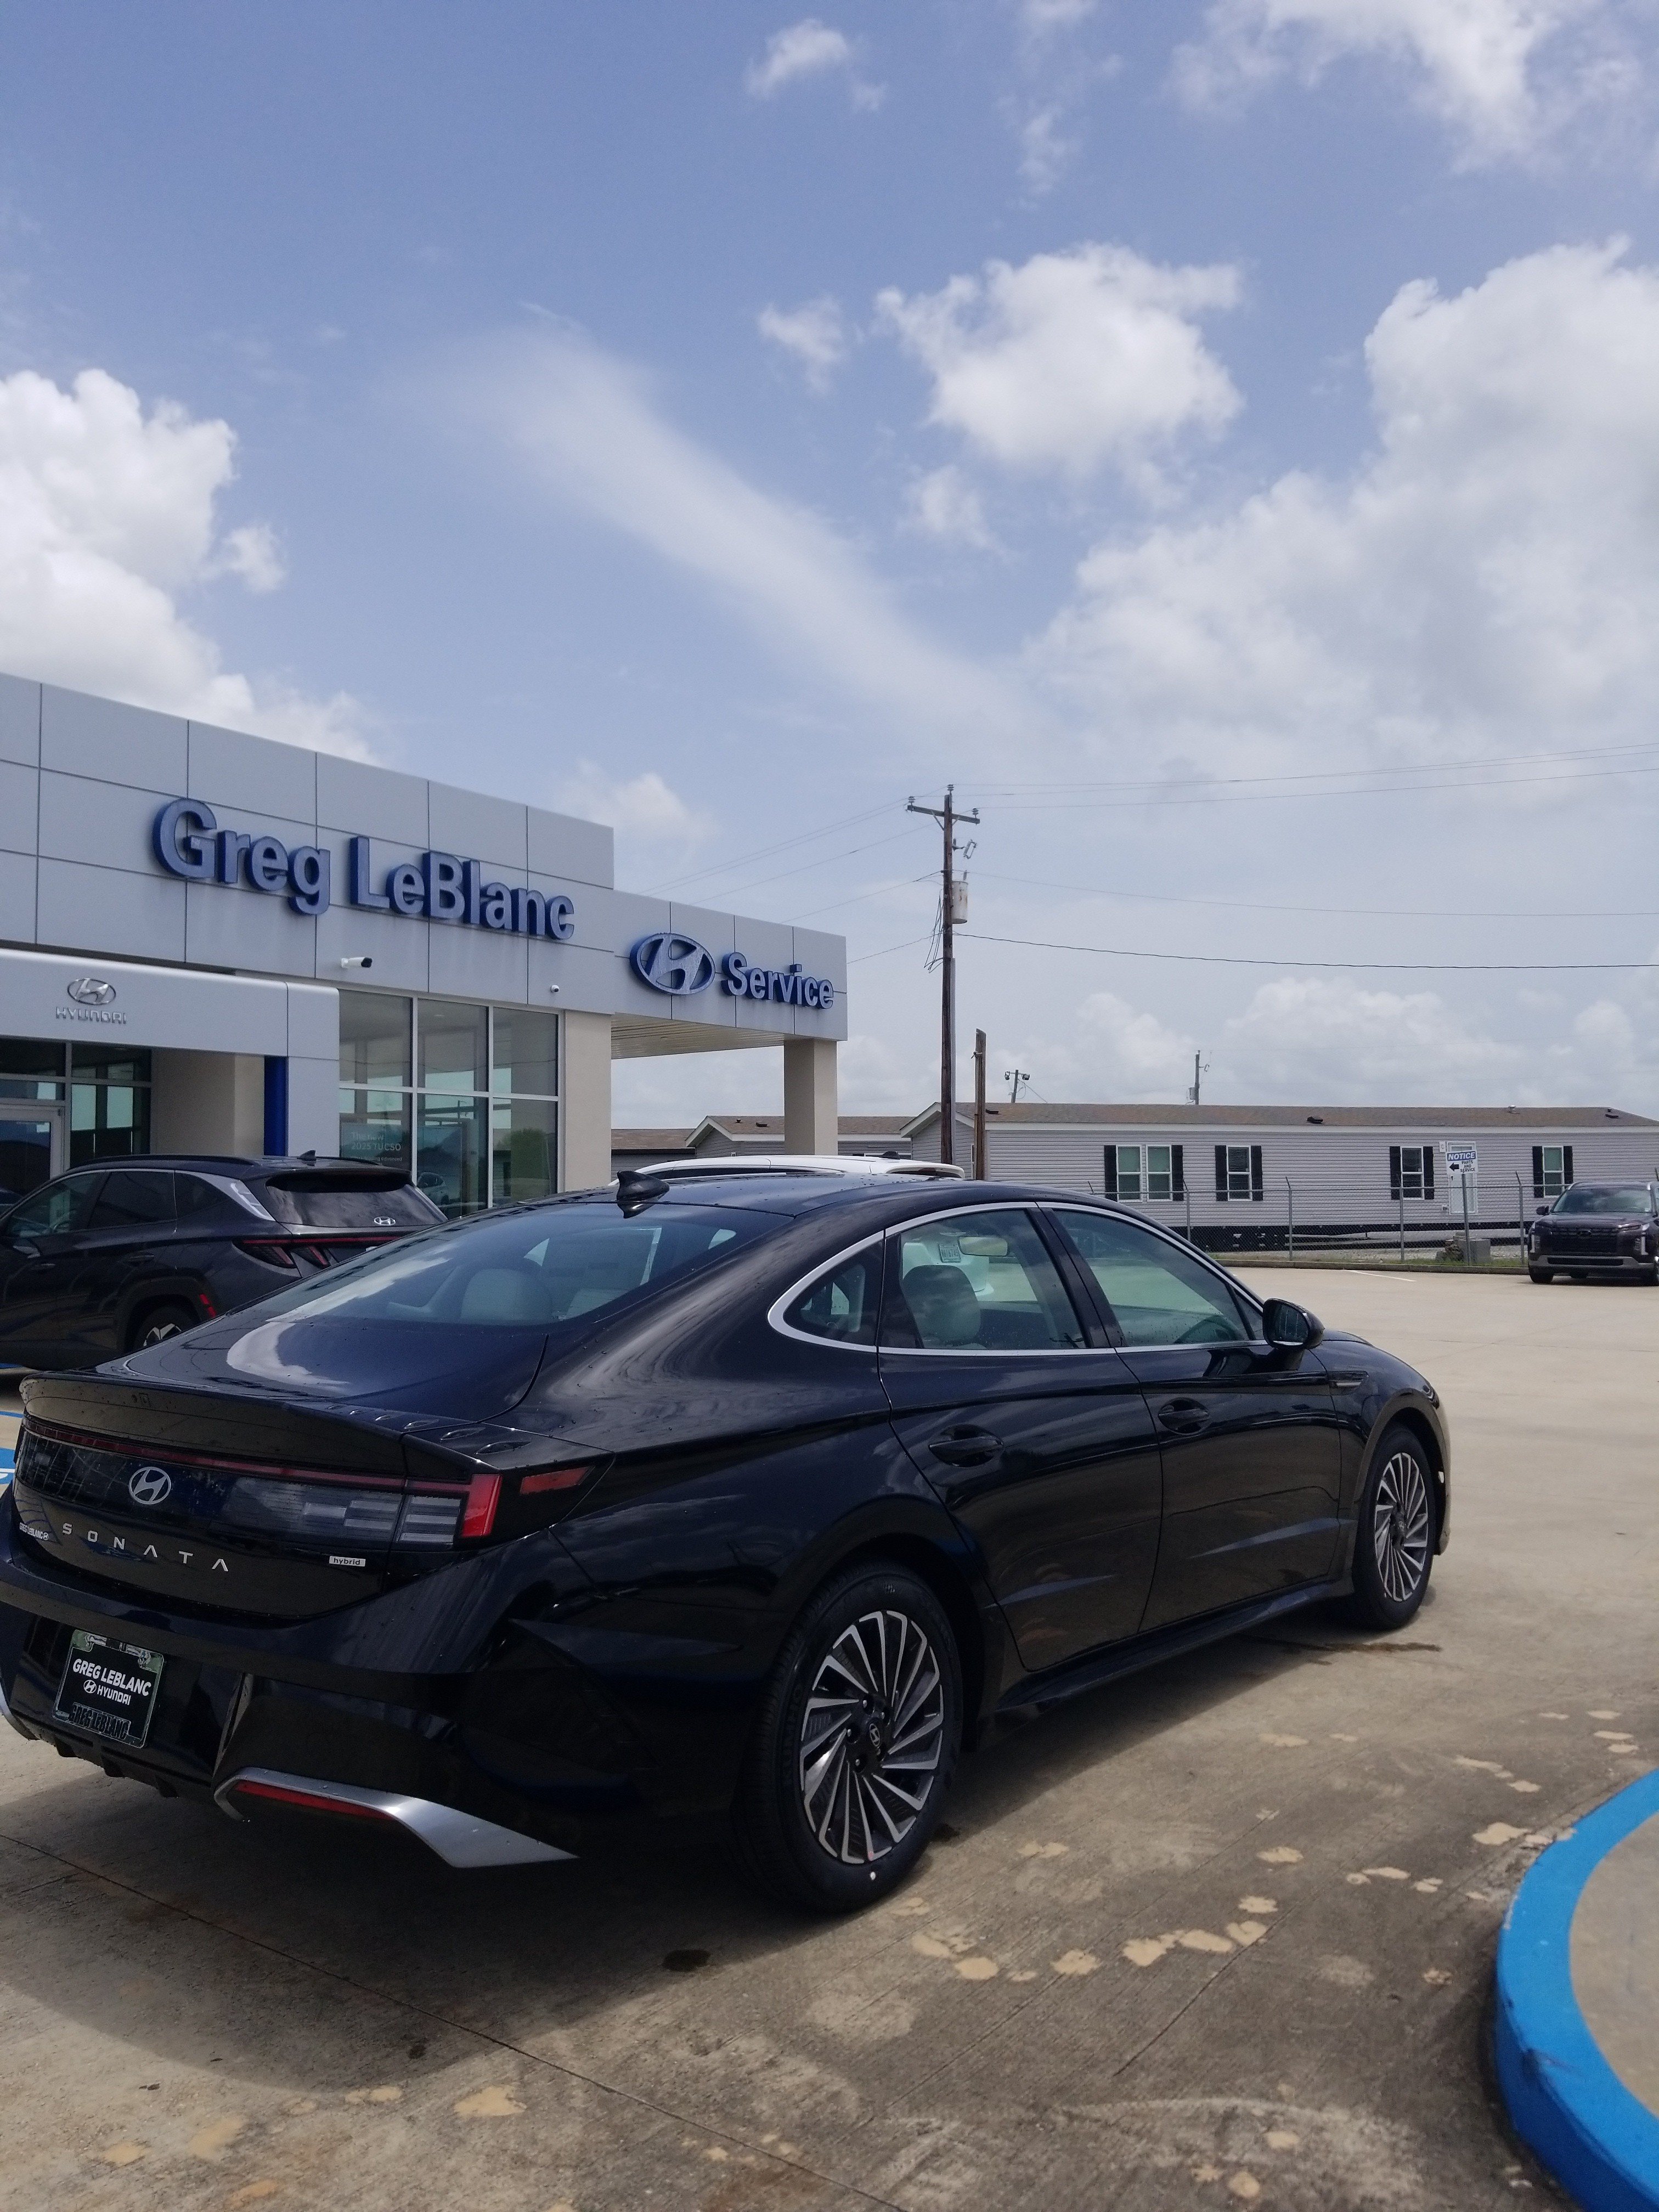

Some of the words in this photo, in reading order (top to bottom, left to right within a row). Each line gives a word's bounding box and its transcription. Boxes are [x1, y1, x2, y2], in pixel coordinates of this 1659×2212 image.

[153, 798, 331, 915] Greg
[349, 836, 574, 940] LeBlanc
[721, 952, 834, 1009] Service
[56, 1006, 126, 1024] HYUNDAI
[62, 1522, 229, 1572] SONATA
[334, 1557, 360, 1565] hybrid
[73, 1658, 101, 1679] GREG
[100, 1668, 151, 1696] LEBLANC
[97, 1684, 132, 1706] HYUNDAI
